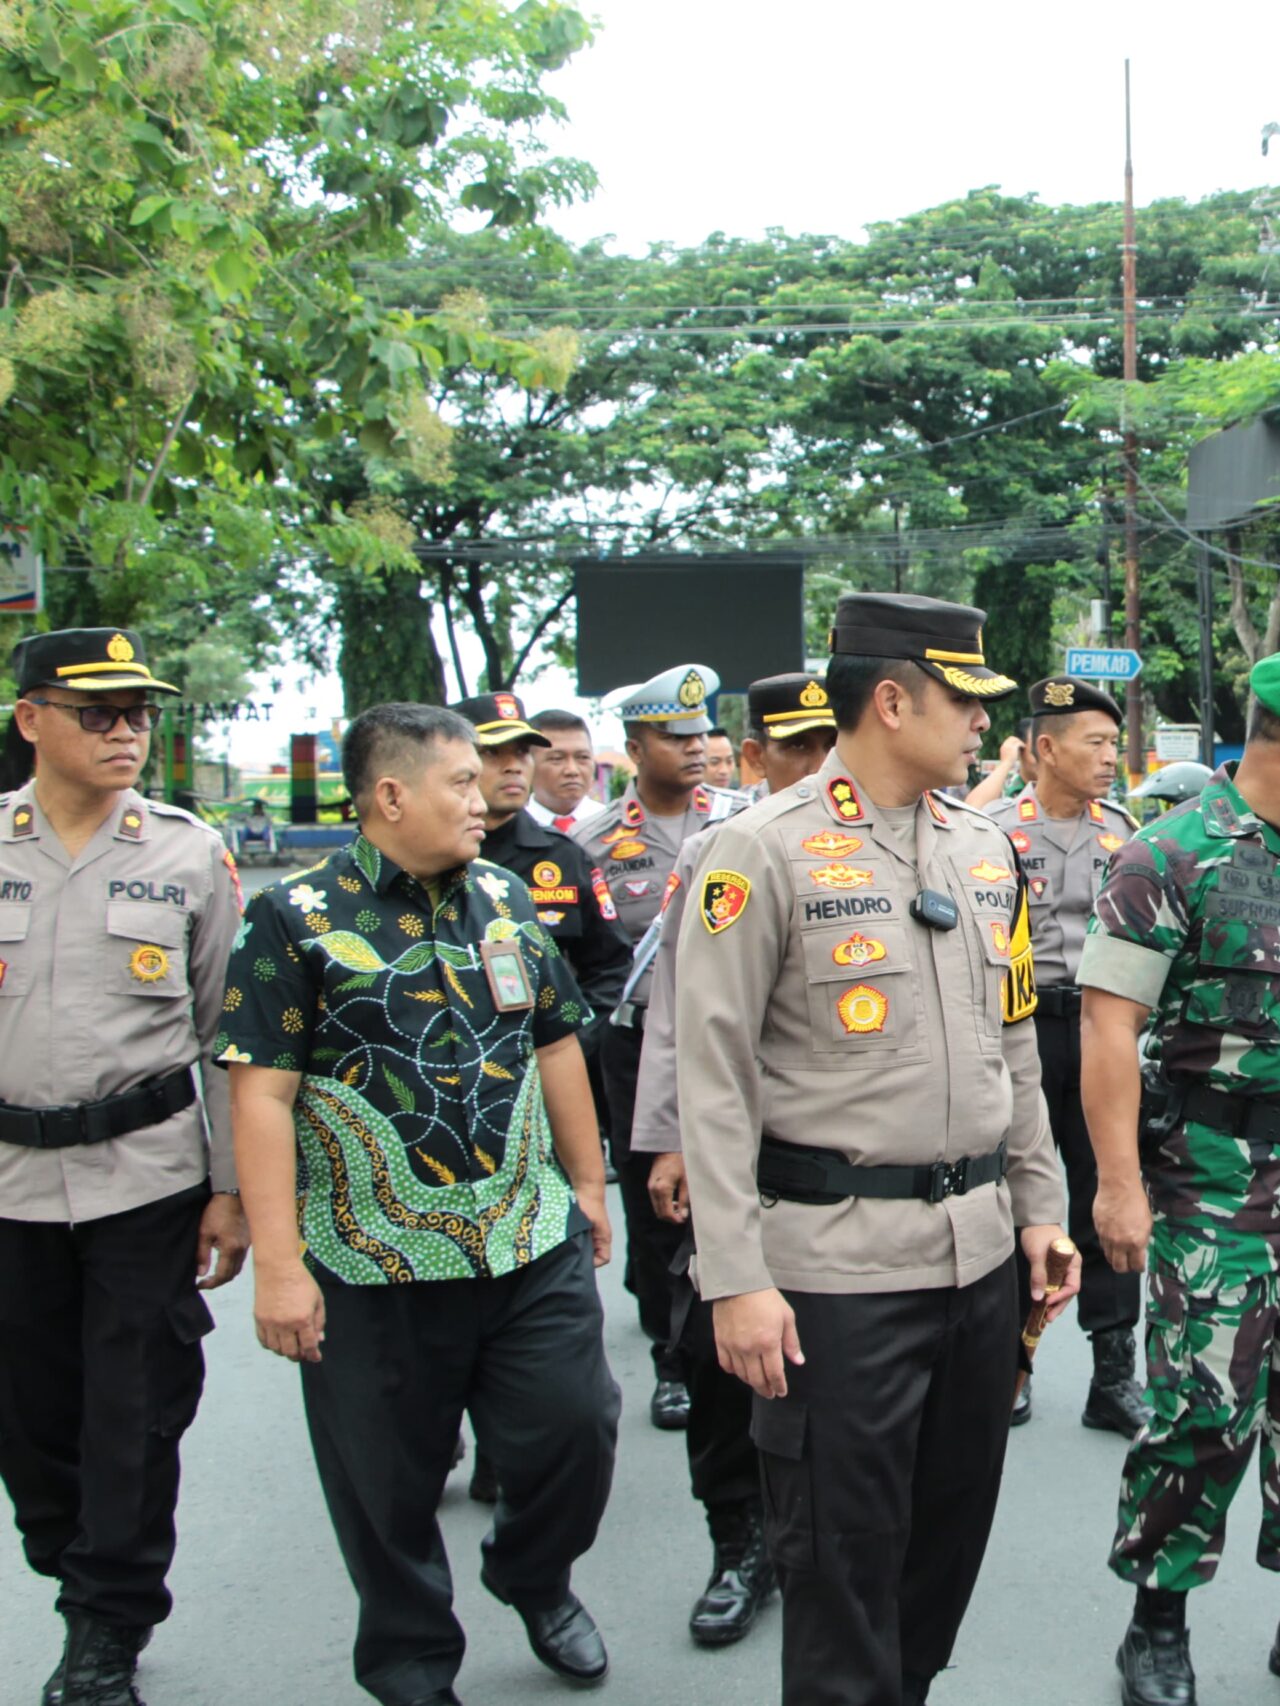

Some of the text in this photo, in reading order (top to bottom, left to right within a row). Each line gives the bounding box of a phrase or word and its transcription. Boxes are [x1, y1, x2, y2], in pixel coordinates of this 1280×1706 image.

[1070, 652, 1131, 674] PEMKAB
[109, 880, 186, 906] POLRI
[529, 888, 574, 901] ENKOM
[805, 897, 892, 921] HENDRO
